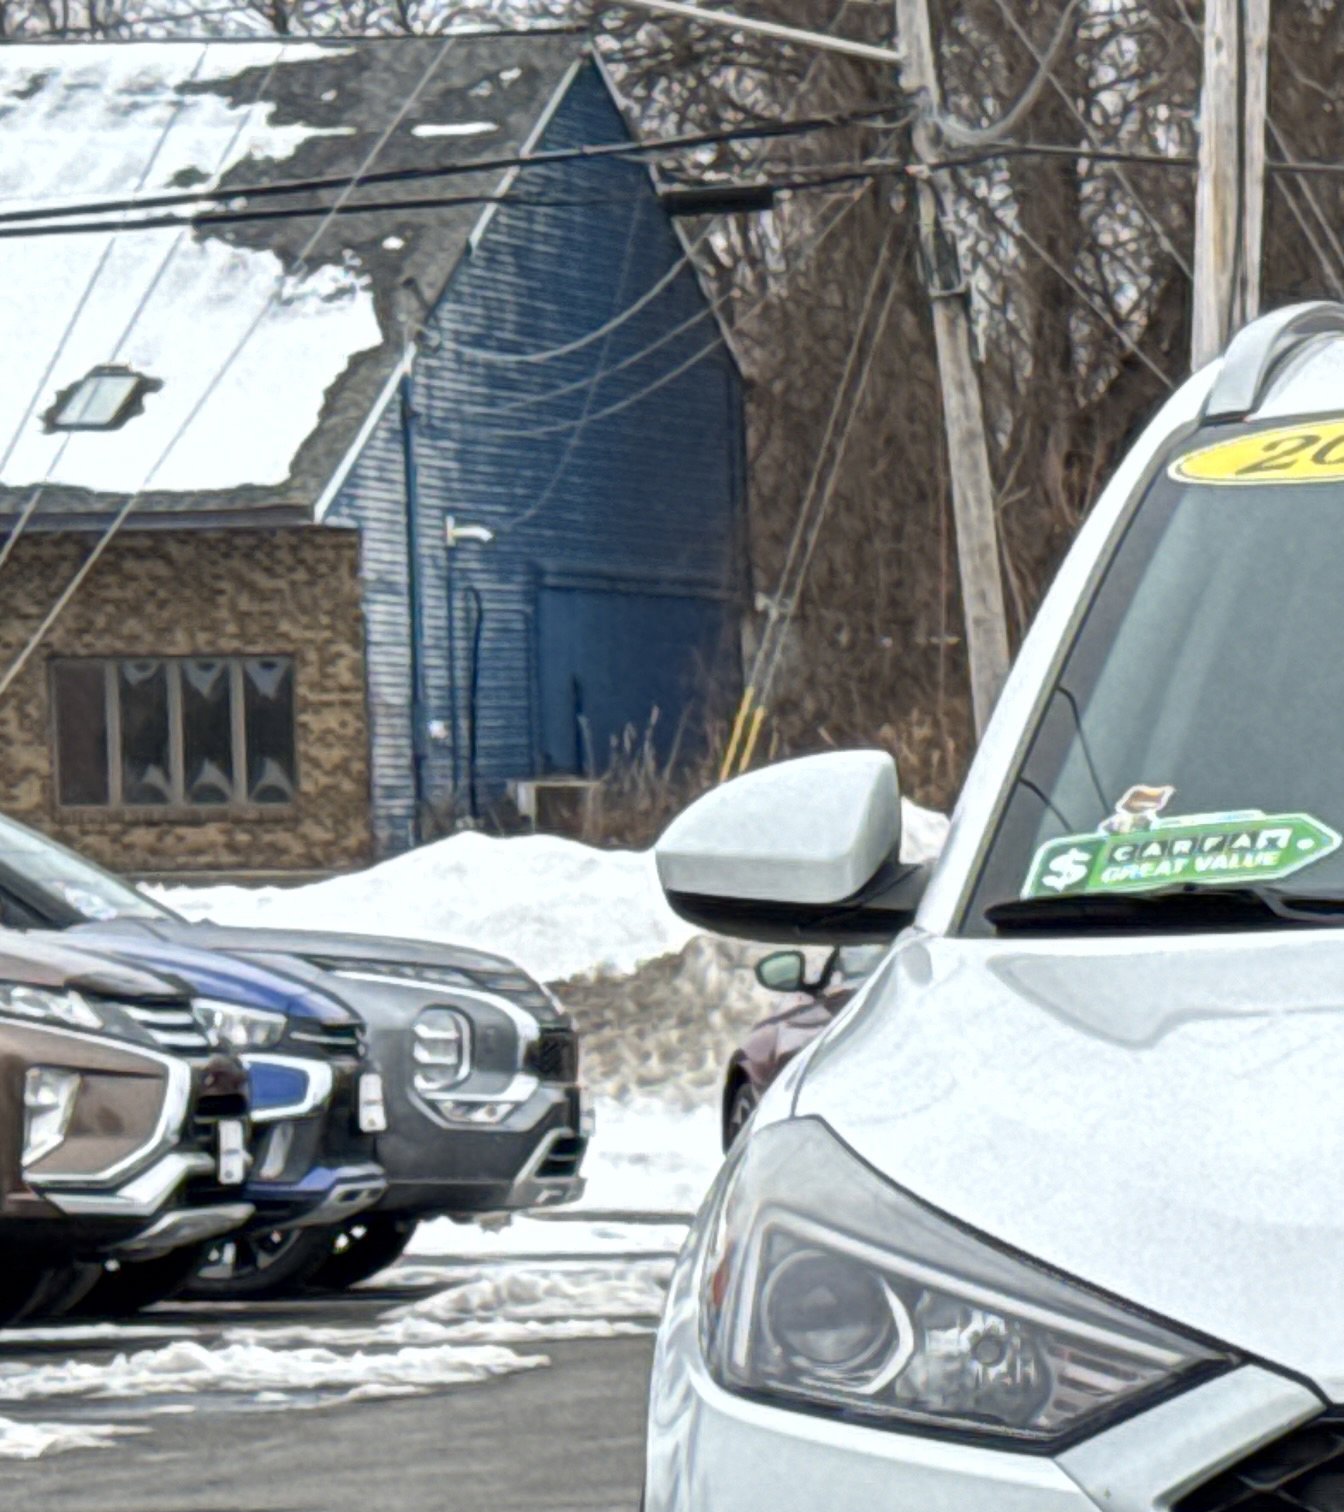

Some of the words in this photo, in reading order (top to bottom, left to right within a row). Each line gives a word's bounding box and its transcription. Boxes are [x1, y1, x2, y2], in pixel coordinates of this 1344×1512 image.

[1111, 828, 1293, 863] CARFAX
[1101, 857, 1191, 884] GREAT
[1194, 850, 1283, 873] VALUE
